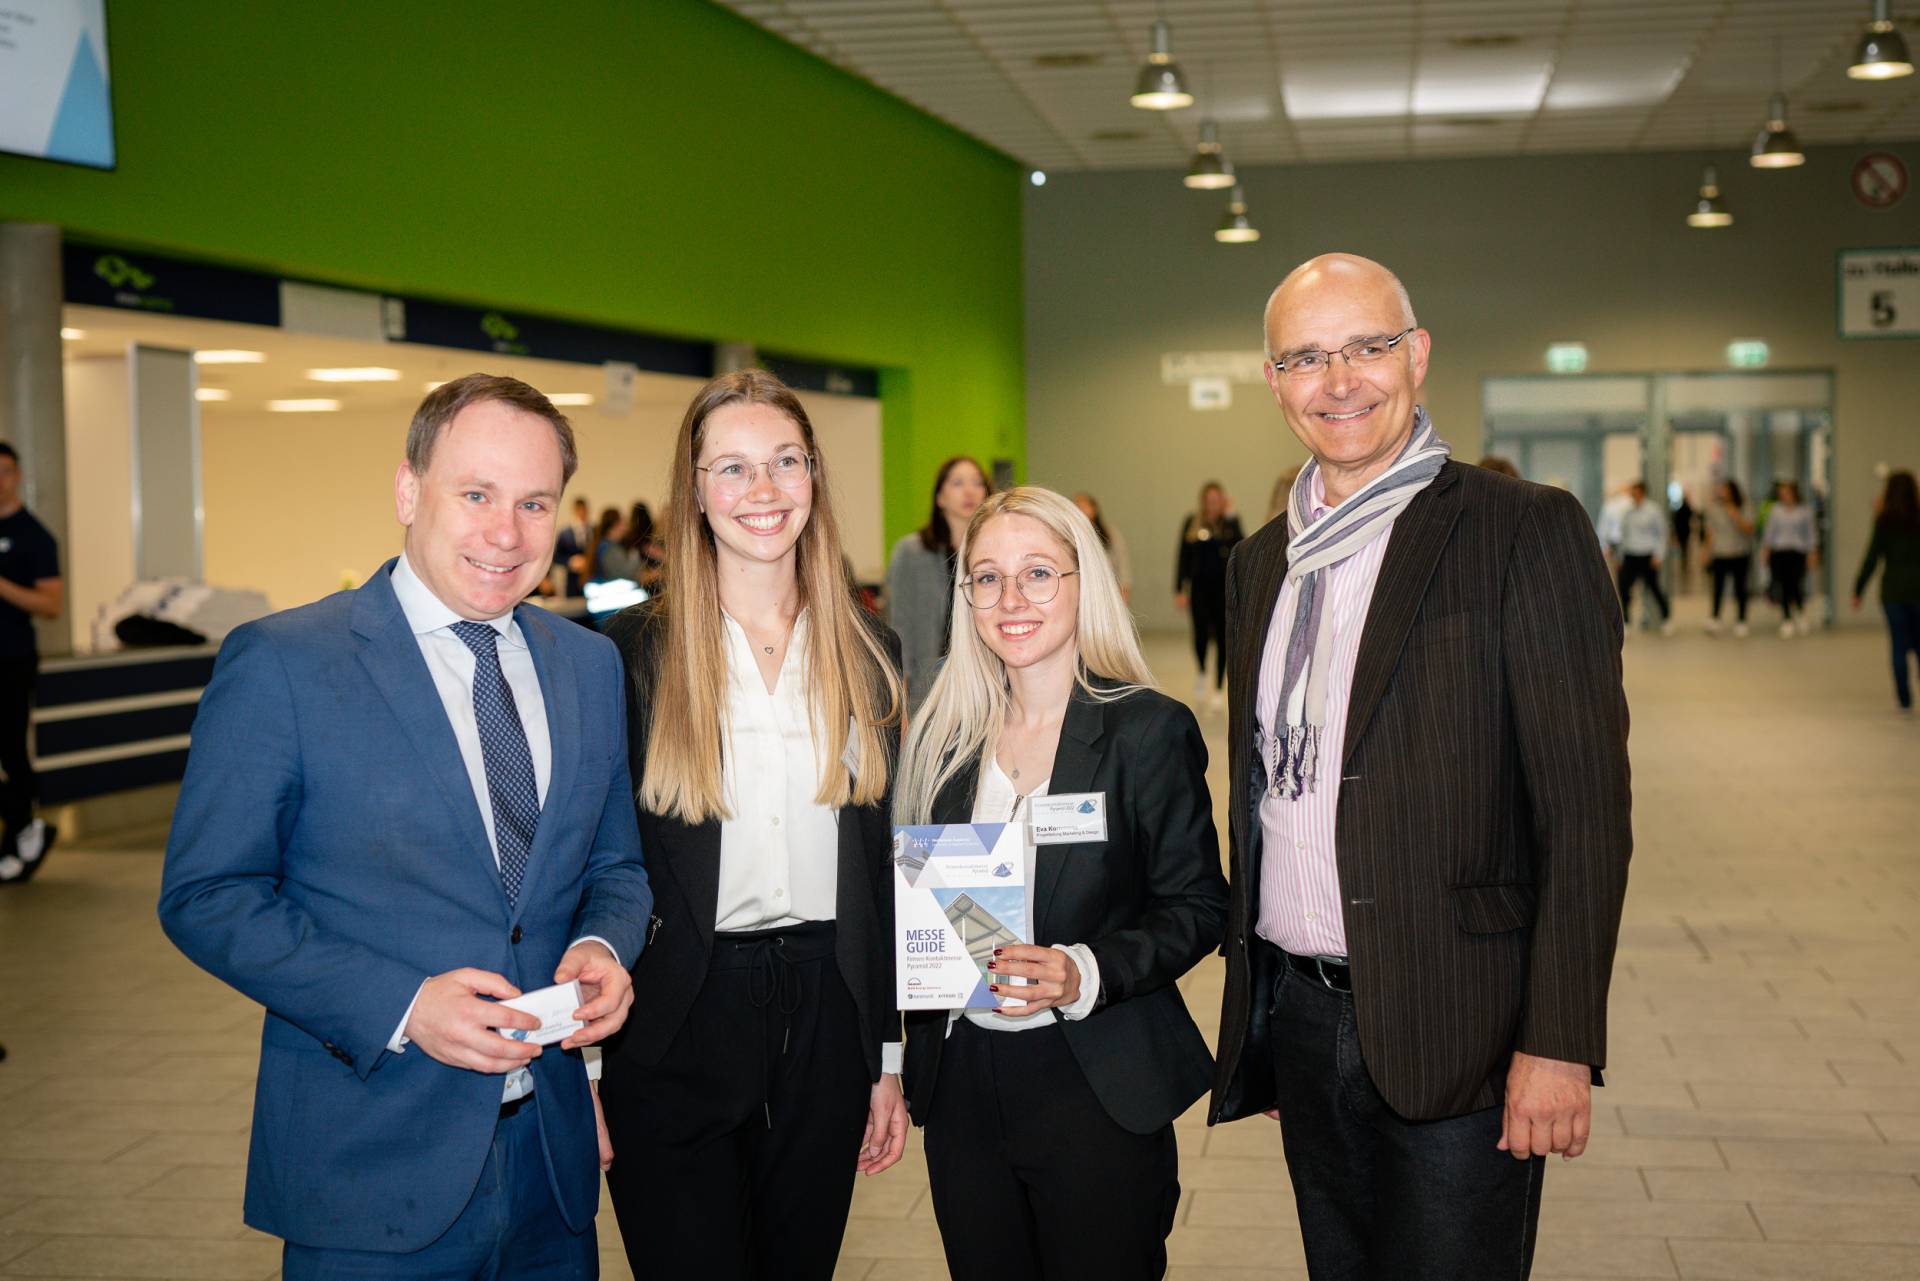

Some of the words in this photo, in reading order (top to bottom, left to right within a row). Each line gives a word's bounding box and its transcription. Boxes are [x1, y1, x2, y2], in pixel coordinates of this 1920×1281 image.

[1871, 290, 1897, 328] 5
[906, 929, 945, 941] MESSE
[906, 941, 946, 953] GUIDE
